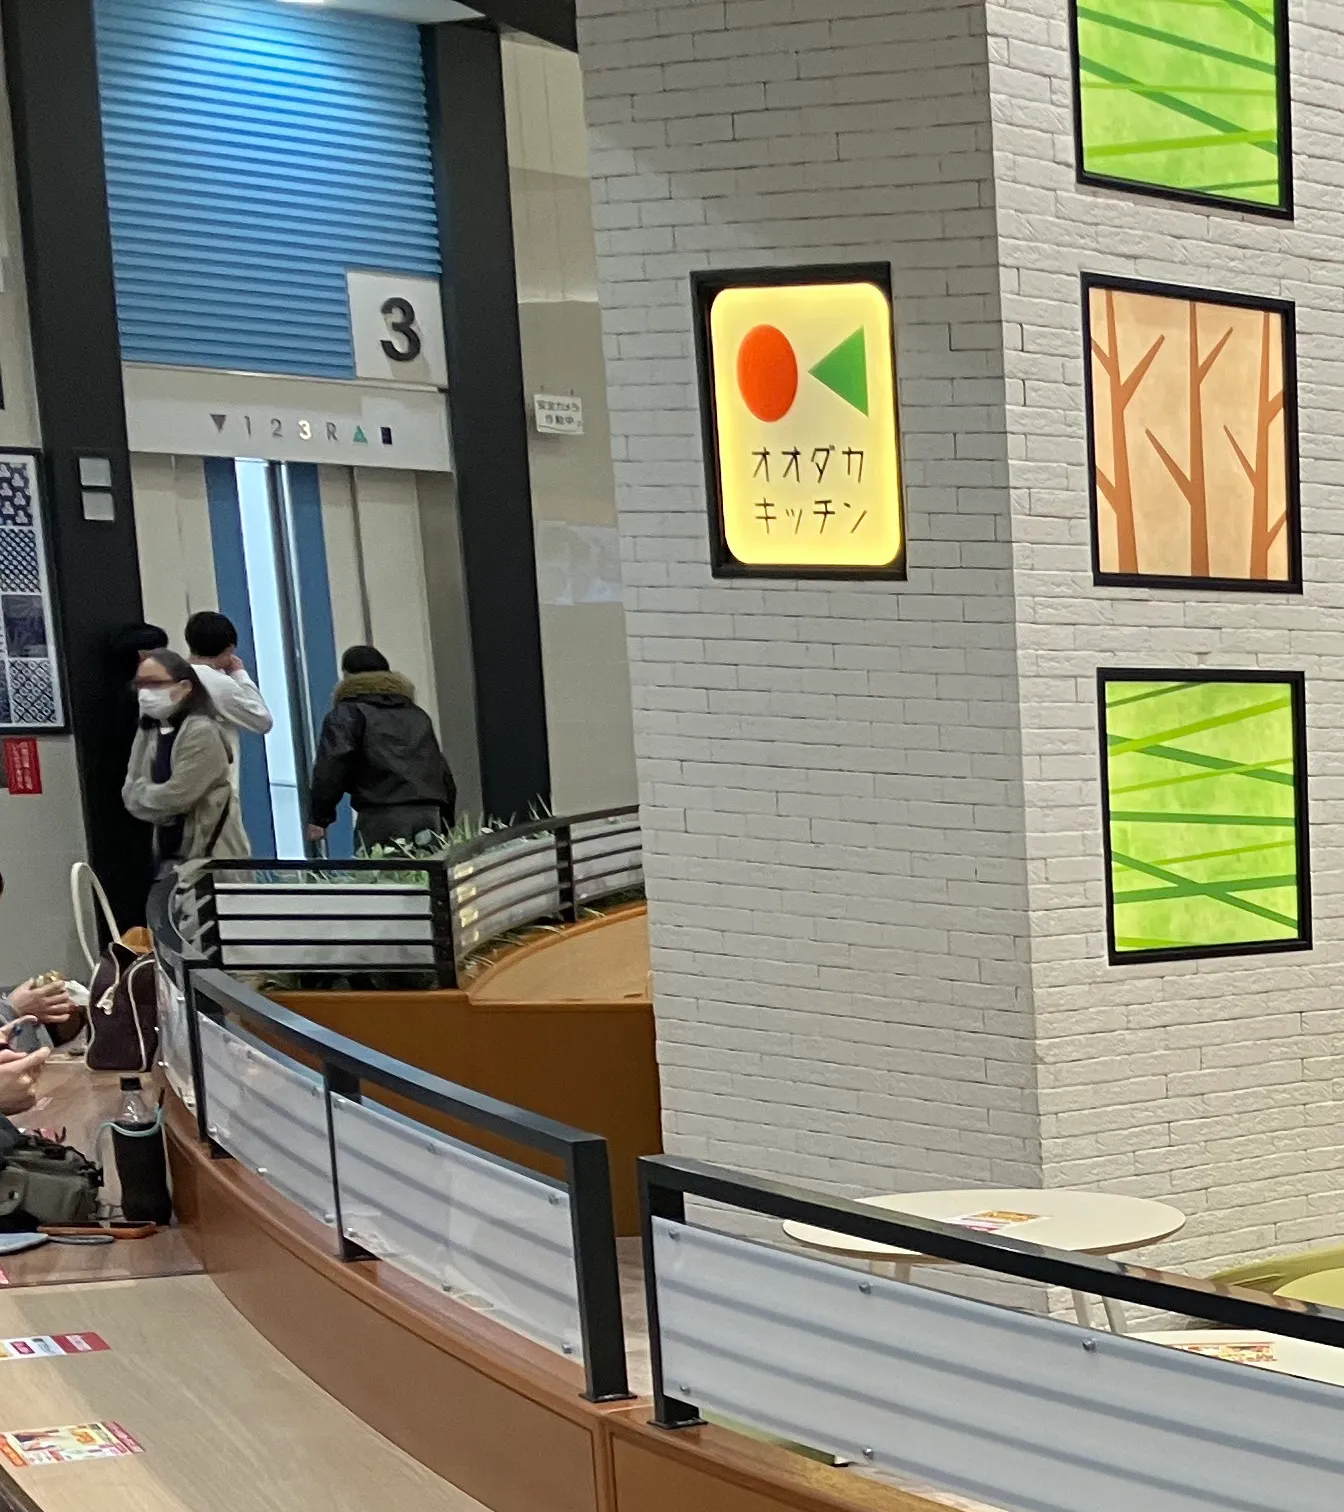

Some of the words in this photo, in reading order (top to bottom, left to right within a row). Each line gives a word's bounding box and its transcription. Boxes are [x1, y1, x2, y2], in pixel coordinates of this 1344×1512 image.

[379, 297, 421, 362] 3
[244, 415, 251, 438] 1
[270, 418, 283, 438] 2
[298, 420, 312, 440] 3
[326, 422, 338, 441] R
[751, 444, 864, 484] オオダカ
[754, 497, 868, 535] キッチン
